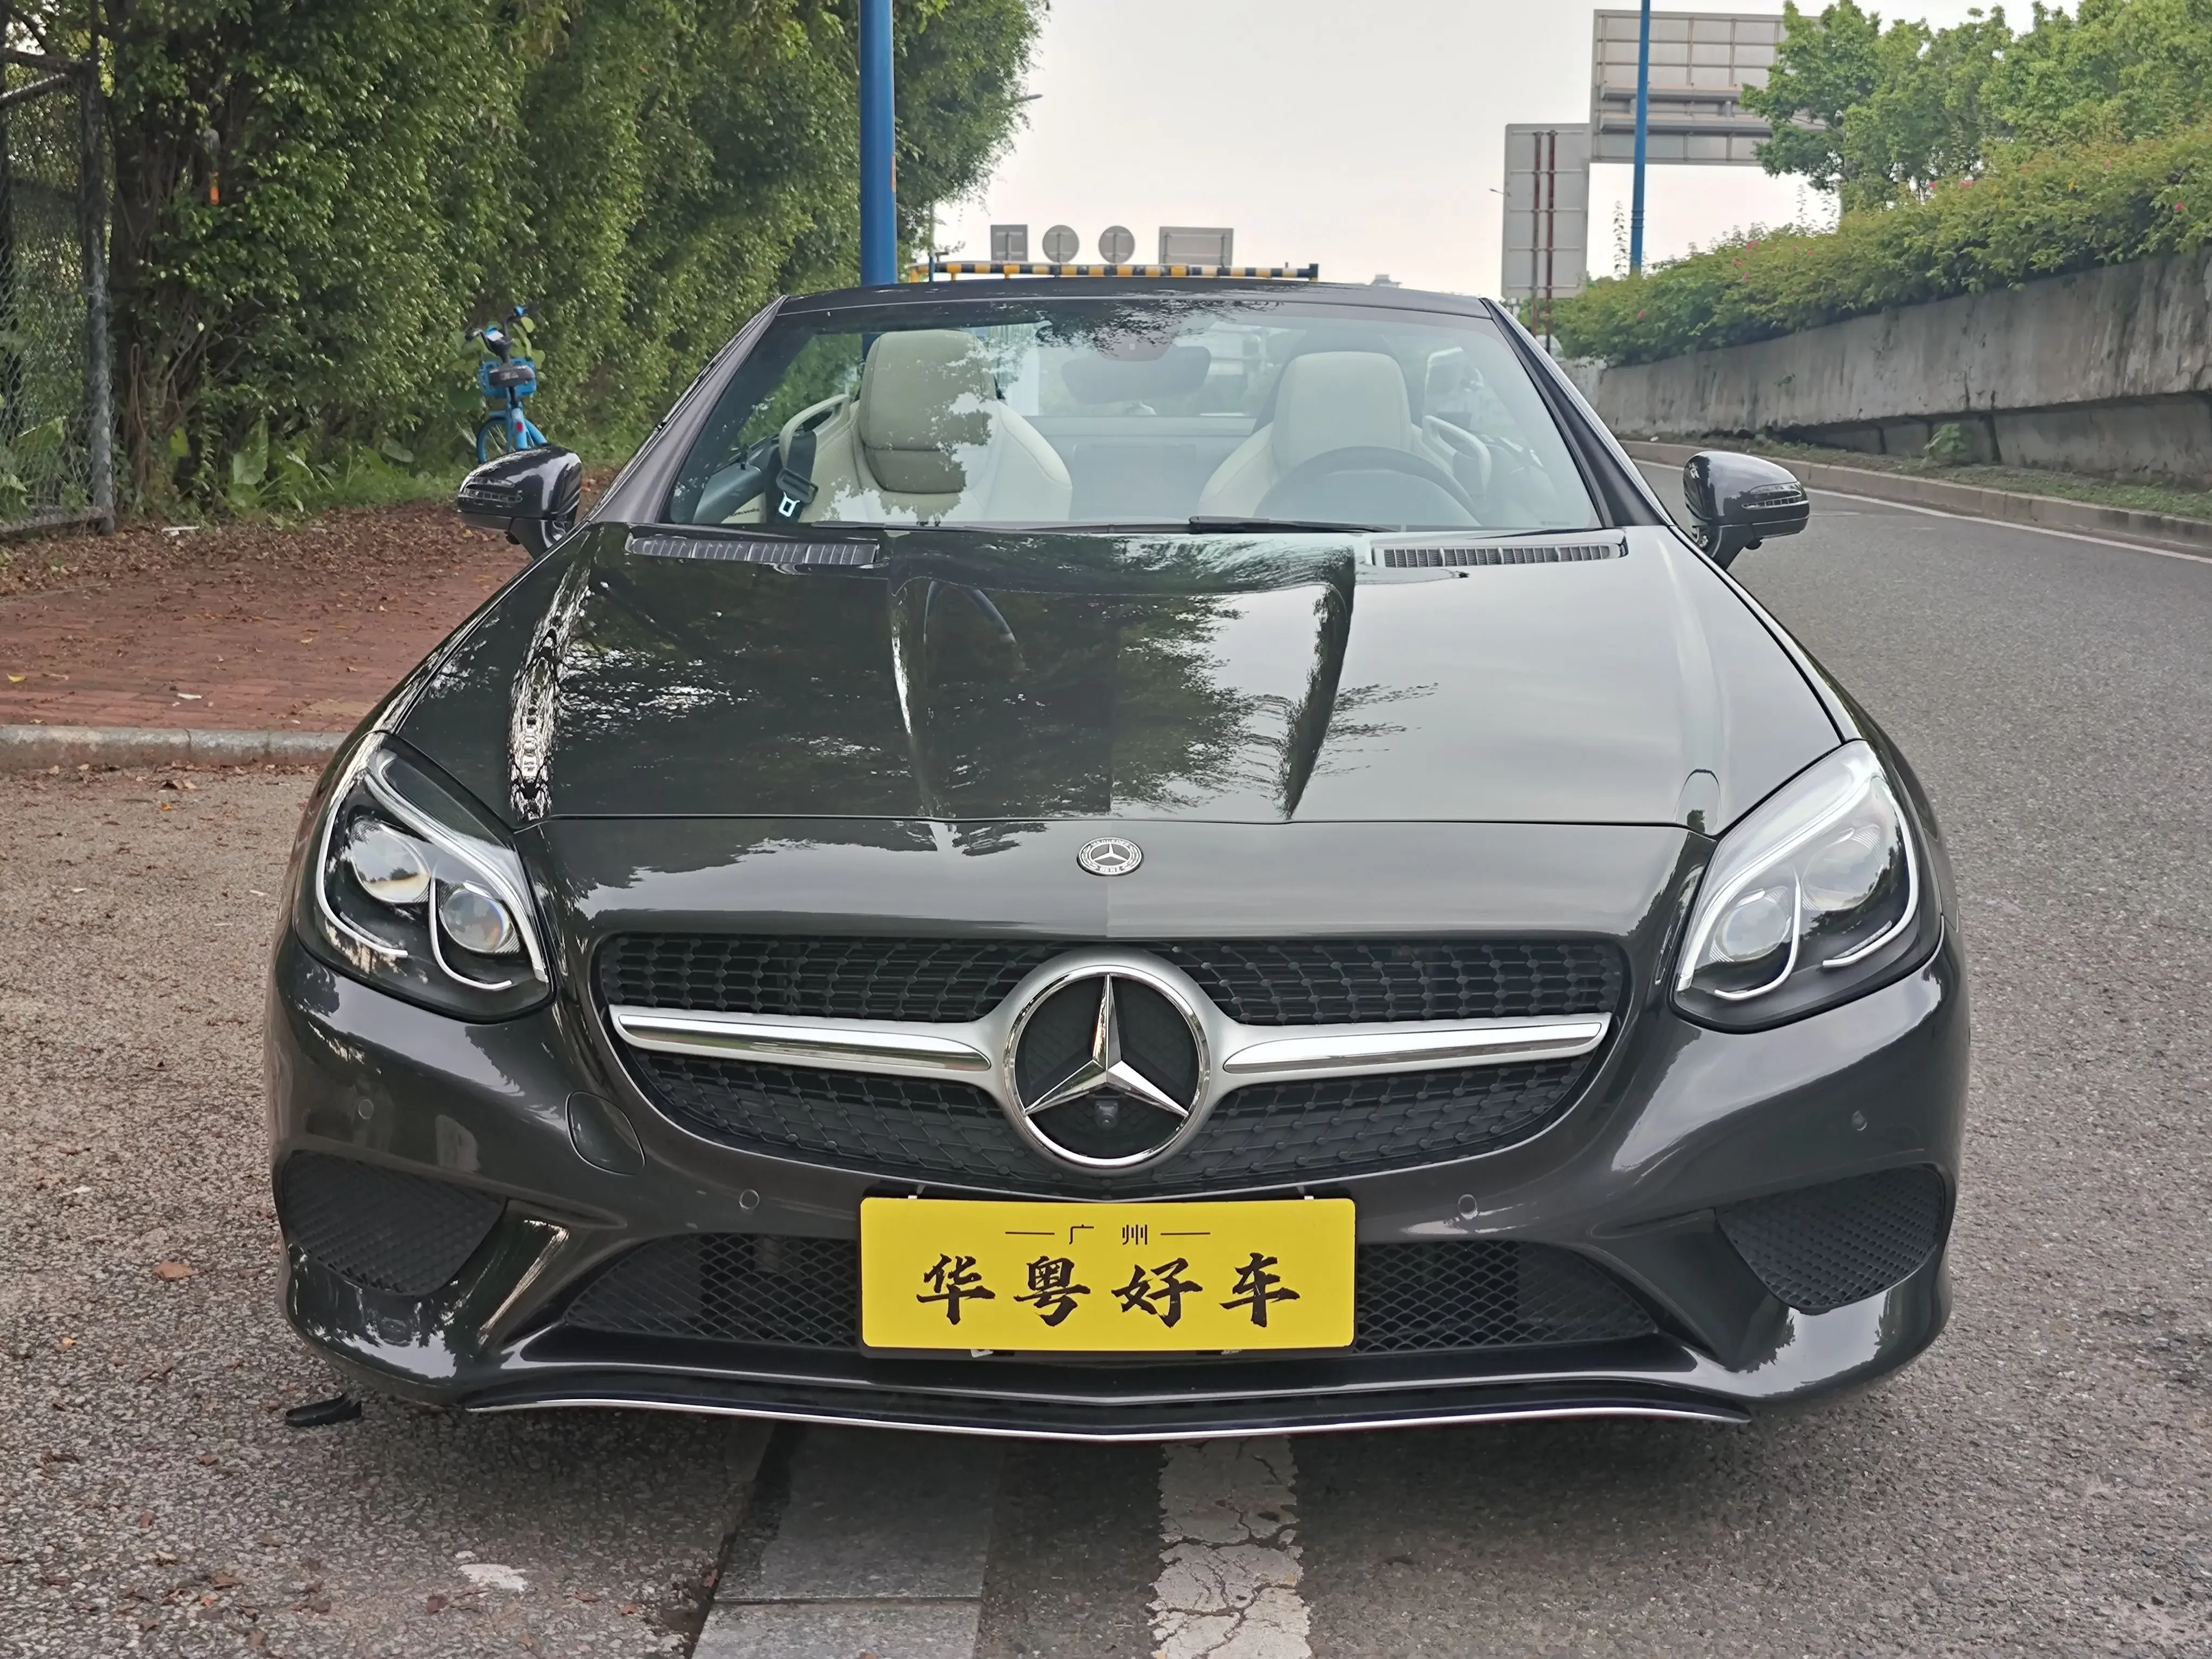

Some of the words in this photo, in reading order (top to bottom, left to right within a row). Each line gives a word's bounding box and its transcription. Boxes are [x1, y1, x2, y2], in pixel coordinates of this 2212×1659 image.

[1069, 1224, 1148, 1245] 广州
[916, 1252, 1300, 1328] 华粤好车
